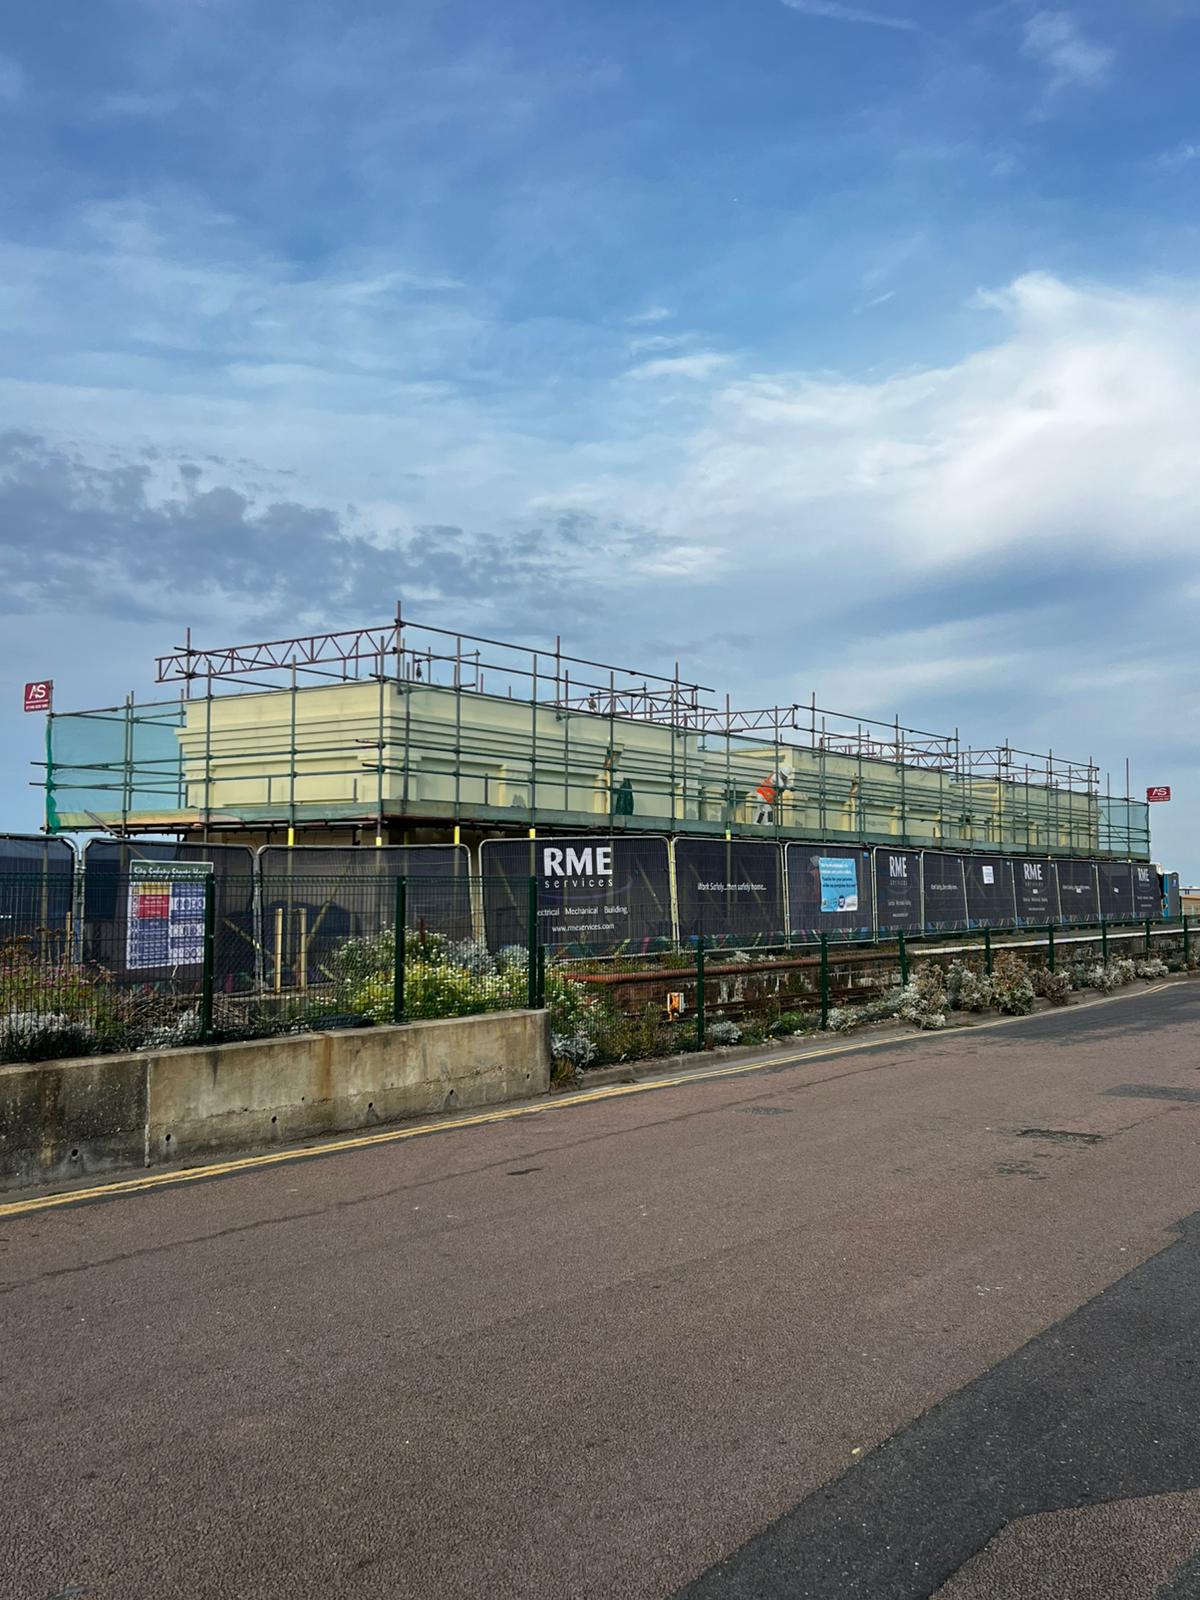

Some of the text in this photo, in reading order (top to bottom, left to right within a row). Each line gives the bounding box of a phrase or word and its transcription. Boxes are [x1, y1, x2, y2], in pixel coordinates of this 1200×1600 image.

[543, 847, 613, 876] RME
[889, 856, 907, 877] RME
[1023, 863, 1043, 880] RME
[544, 878, 613, 888] services
[537, 905, 629, 916] ectrical Mechanical Building
